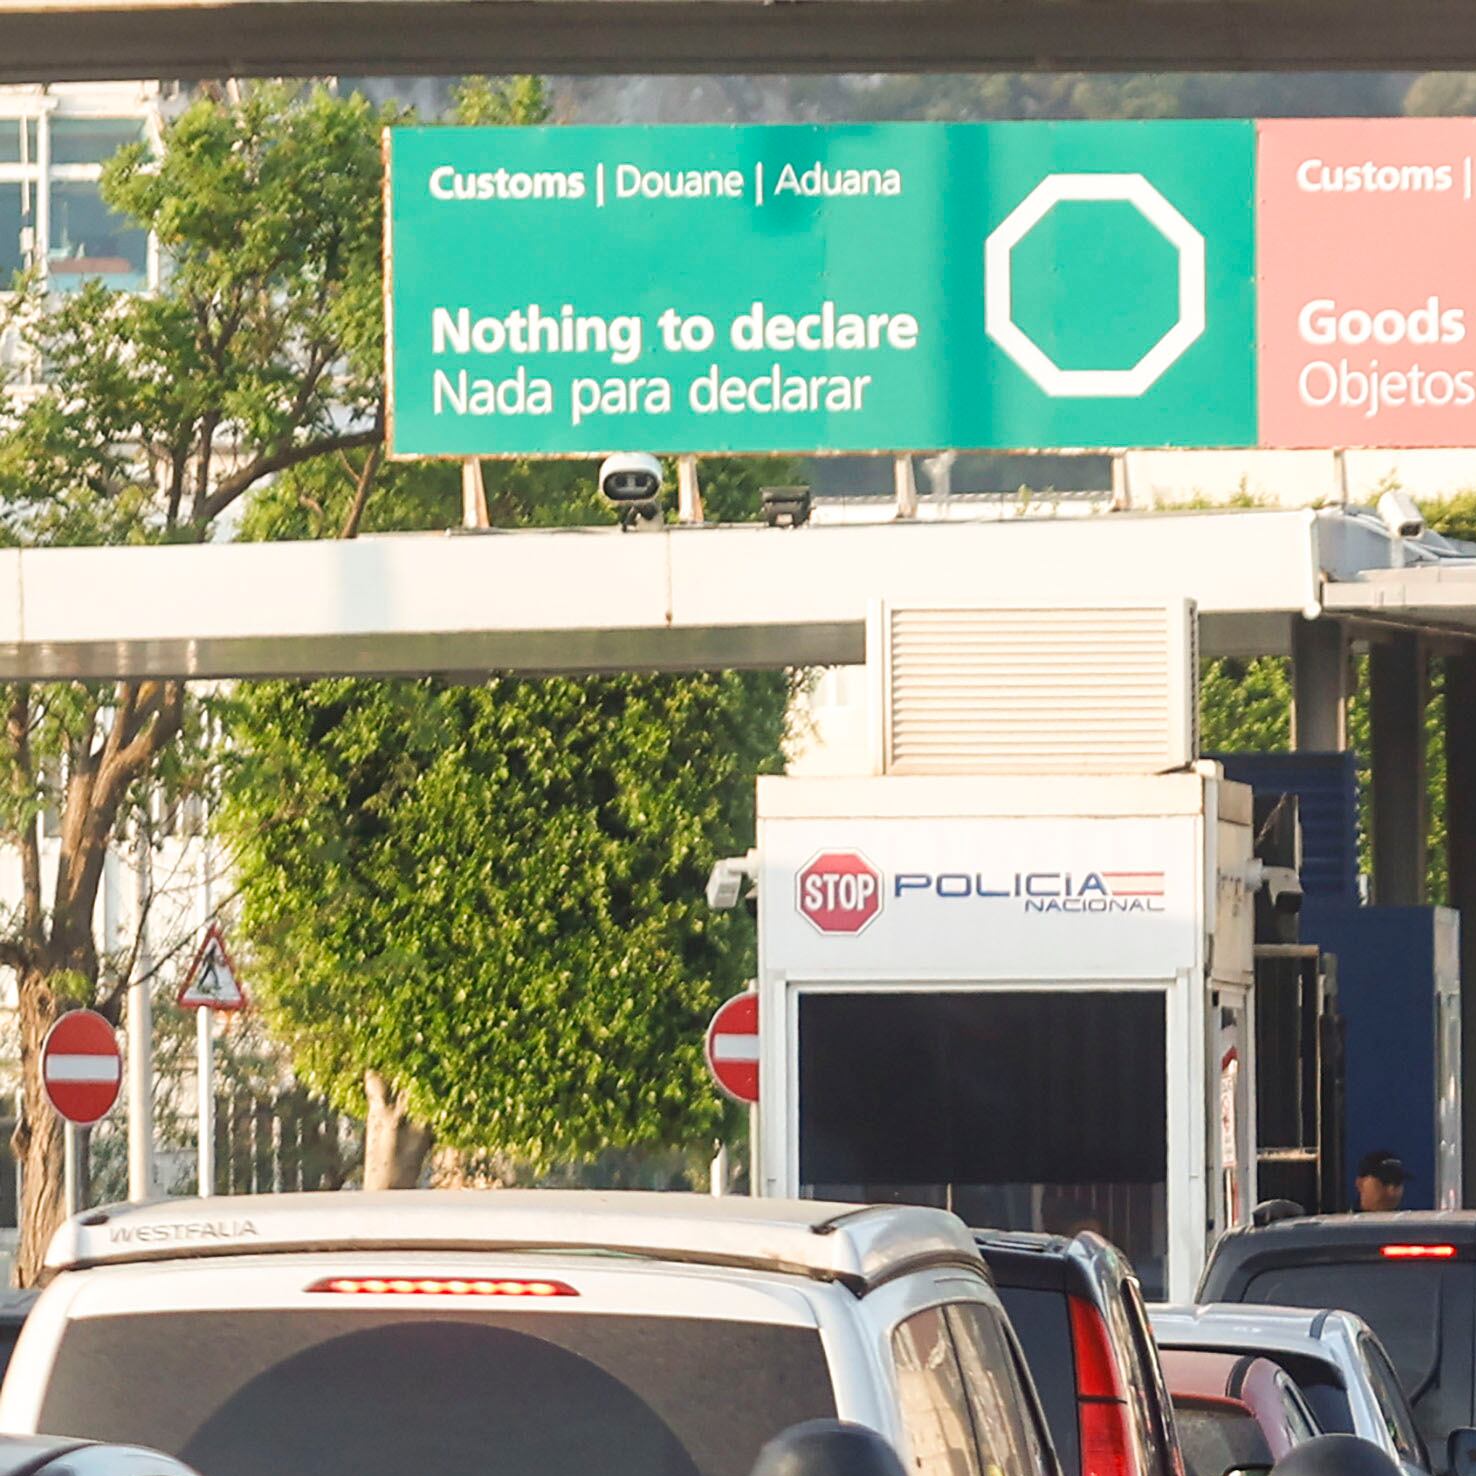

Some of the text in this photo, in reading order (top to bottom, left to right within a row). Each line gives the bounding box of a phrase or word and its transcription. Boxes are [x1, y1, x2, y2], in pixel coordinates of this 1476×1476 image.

[429, 162, 902, 200] Customs Douane Aduana
[1296, 159, 1452, 192] Customs
[432, 302, 918, 365] Nothing to declare
[1298, 296, 1466, 345] Goods
[433, 363, 872, 426] Nada para declarar
[1298, 358, 1476, 418] Objetos
[804, 872, 876, 912] STOP
[1024, 898, 1165, 913] NACIONAL
[109, 1219, 260, 1244] WESTFALIA
